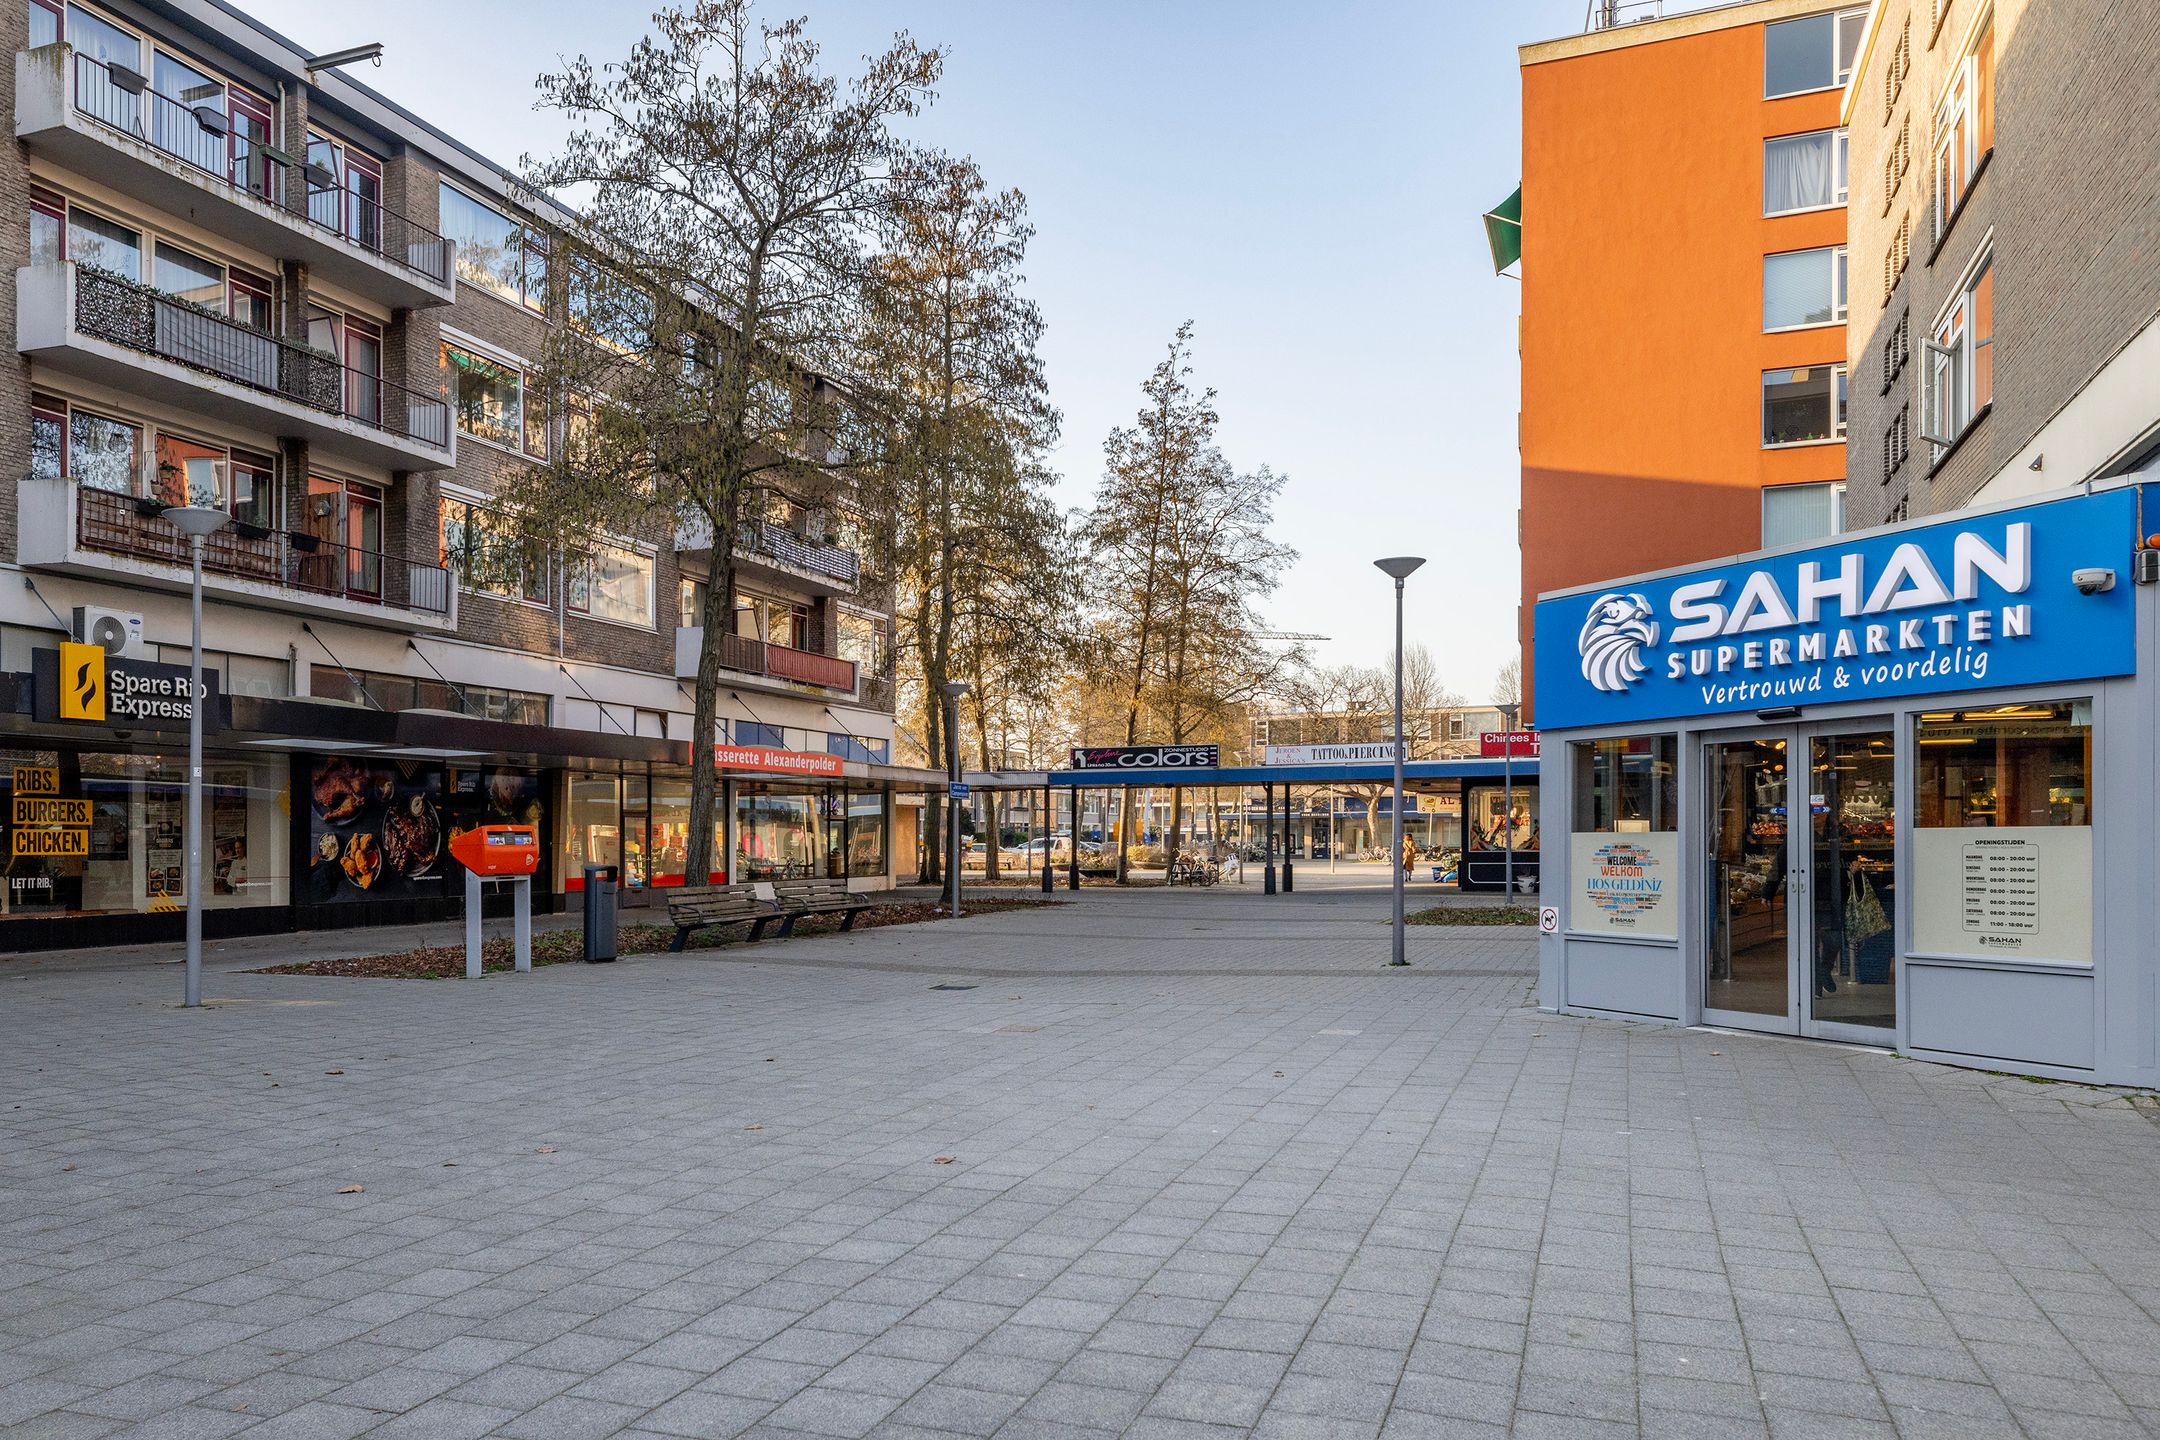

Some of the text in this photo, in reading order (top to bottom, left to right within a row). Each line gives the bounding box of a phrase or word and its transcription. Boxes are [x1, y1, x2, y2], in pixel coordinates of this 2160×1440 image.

[1669, 522, 2031, 643] SAHAN
[1667, 604, 2031, 679] SUPERMARKTEN
[111, 669, 172, 696] Spare
[1702, 646, 1989, 704] Vertrouwd & voordelig
[111, 692, 192, 719] Express
[764, 752, 837, 773] Alexanderpolder
[1118, 748, 1209, 767] colors
[16, 769, 56, 791] RIBS.
[16, 800, 90, 822] BURGERS.
[15, 831, 86, 853] CHICKEN.
[1600, 866, 1643, 877] WELKOM
[1606, 856, 1637, 866] WELCOME
[12, 877, 27, 889] LET
[27, 877, 36, 889] IT
